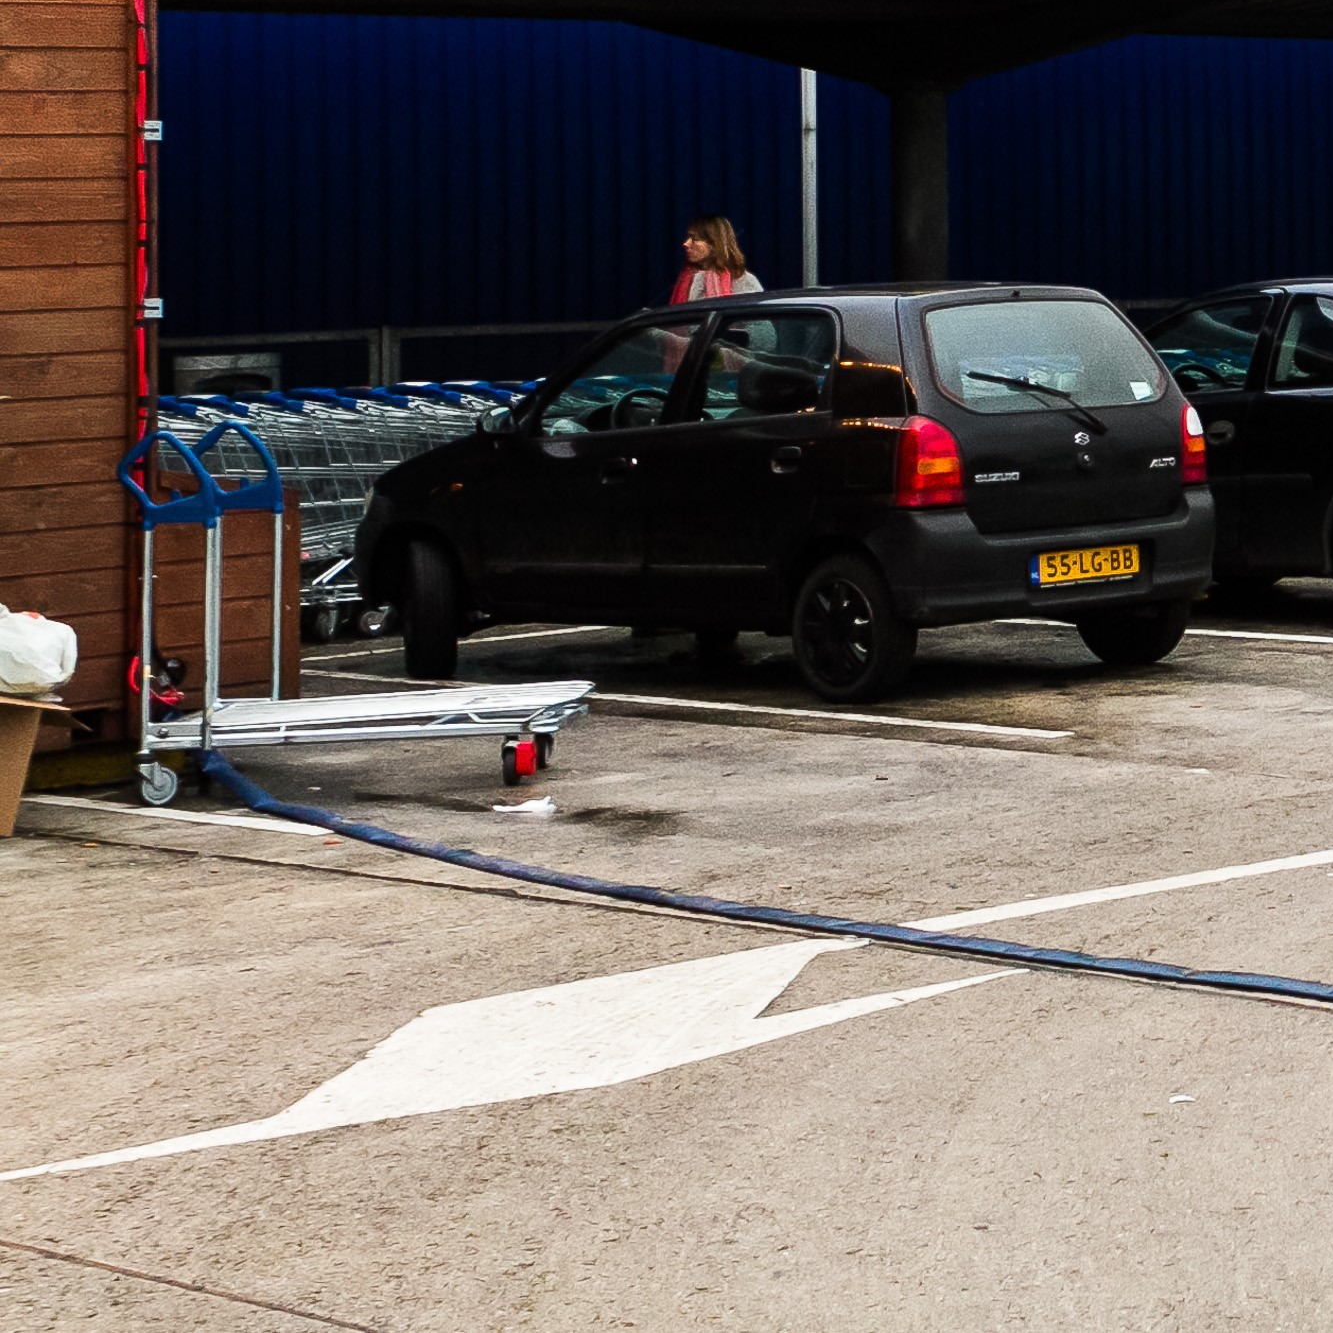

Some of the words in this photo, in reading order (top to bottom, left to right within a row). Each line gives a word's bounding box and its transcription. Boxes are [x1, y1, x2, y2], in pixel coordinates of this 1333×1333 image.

[1149, 456, 1176, 468] ALTO
[974, 471, 1020, 483] SUZUKI
[1046, 548, 1134, 578] 55-LG-BB
